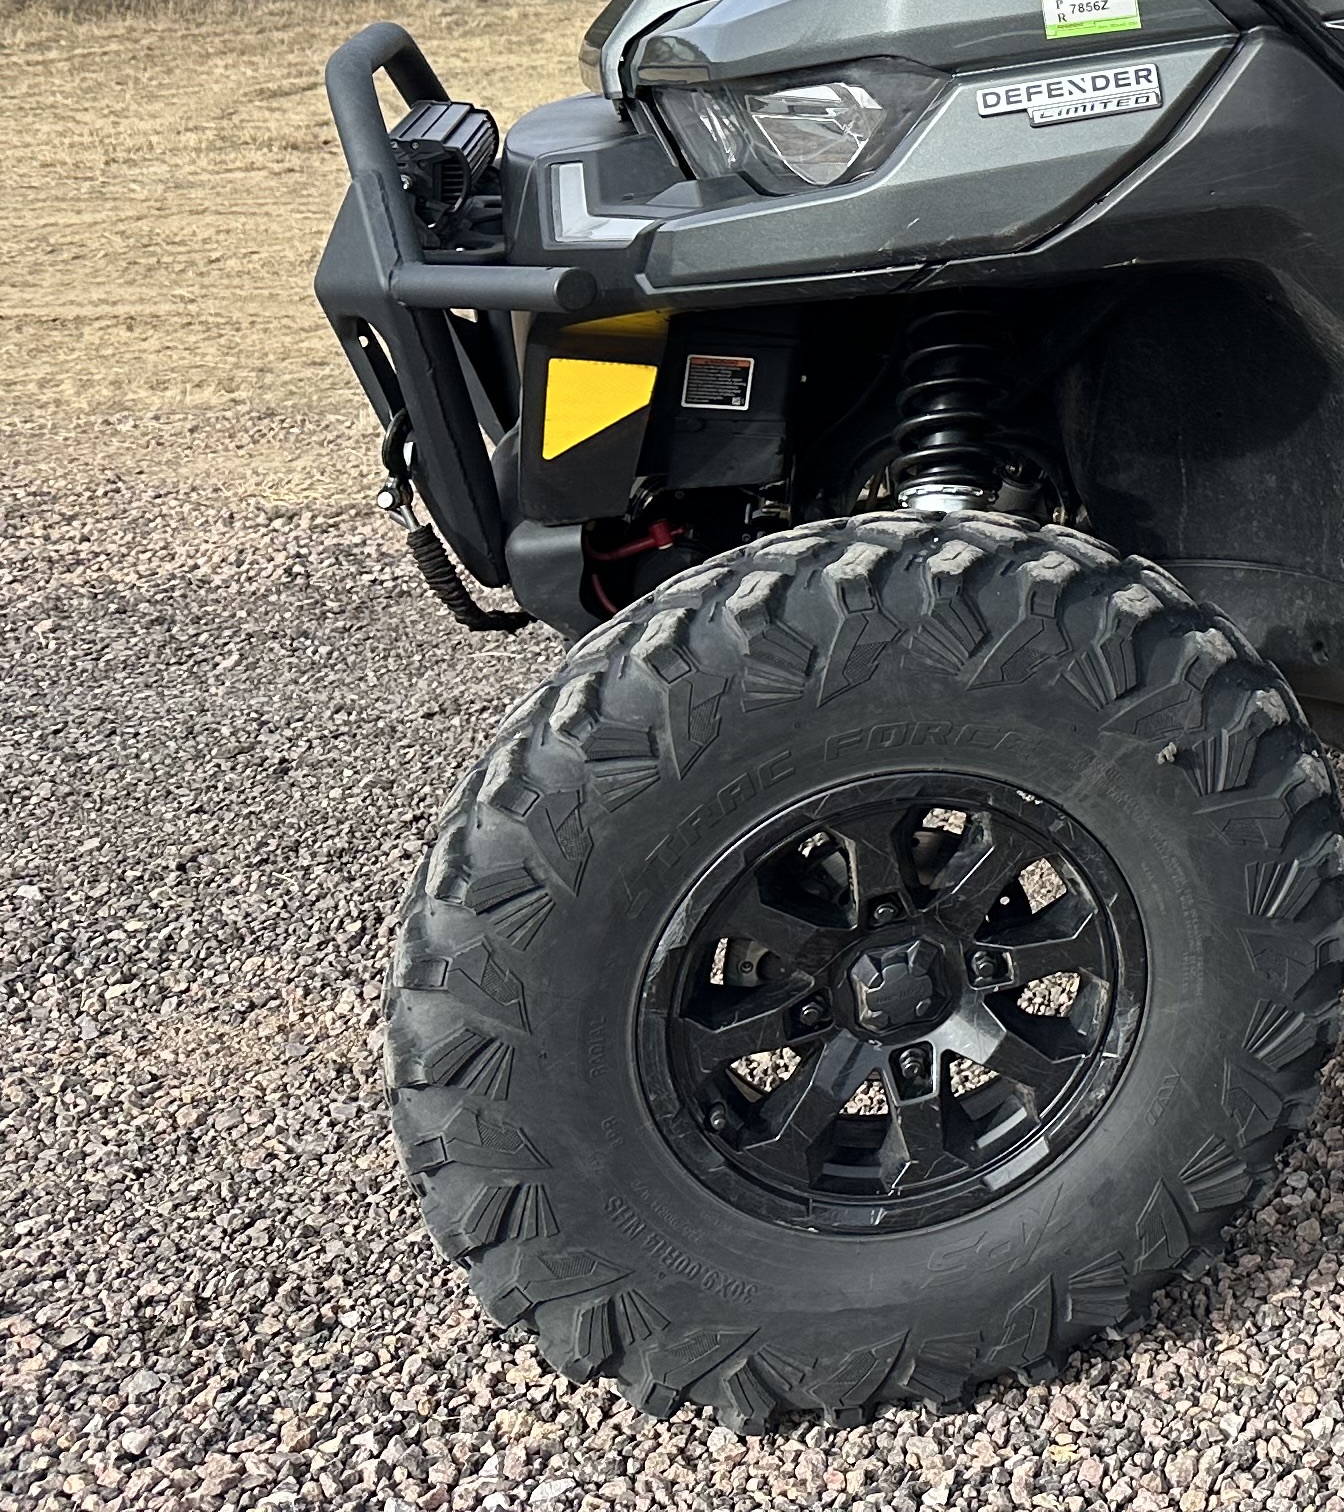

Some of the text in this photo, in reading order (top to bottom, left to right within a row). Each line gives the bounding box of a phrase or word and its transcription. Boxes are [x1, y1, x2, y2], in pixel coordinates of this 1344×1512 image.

[1069, 0, 1111, 14] 7856Z
[982, 67, 1154, 109] DEFENDER
[645, 749, 797, 869] TRAC
[603, 1195, 647, 1239] NHS
